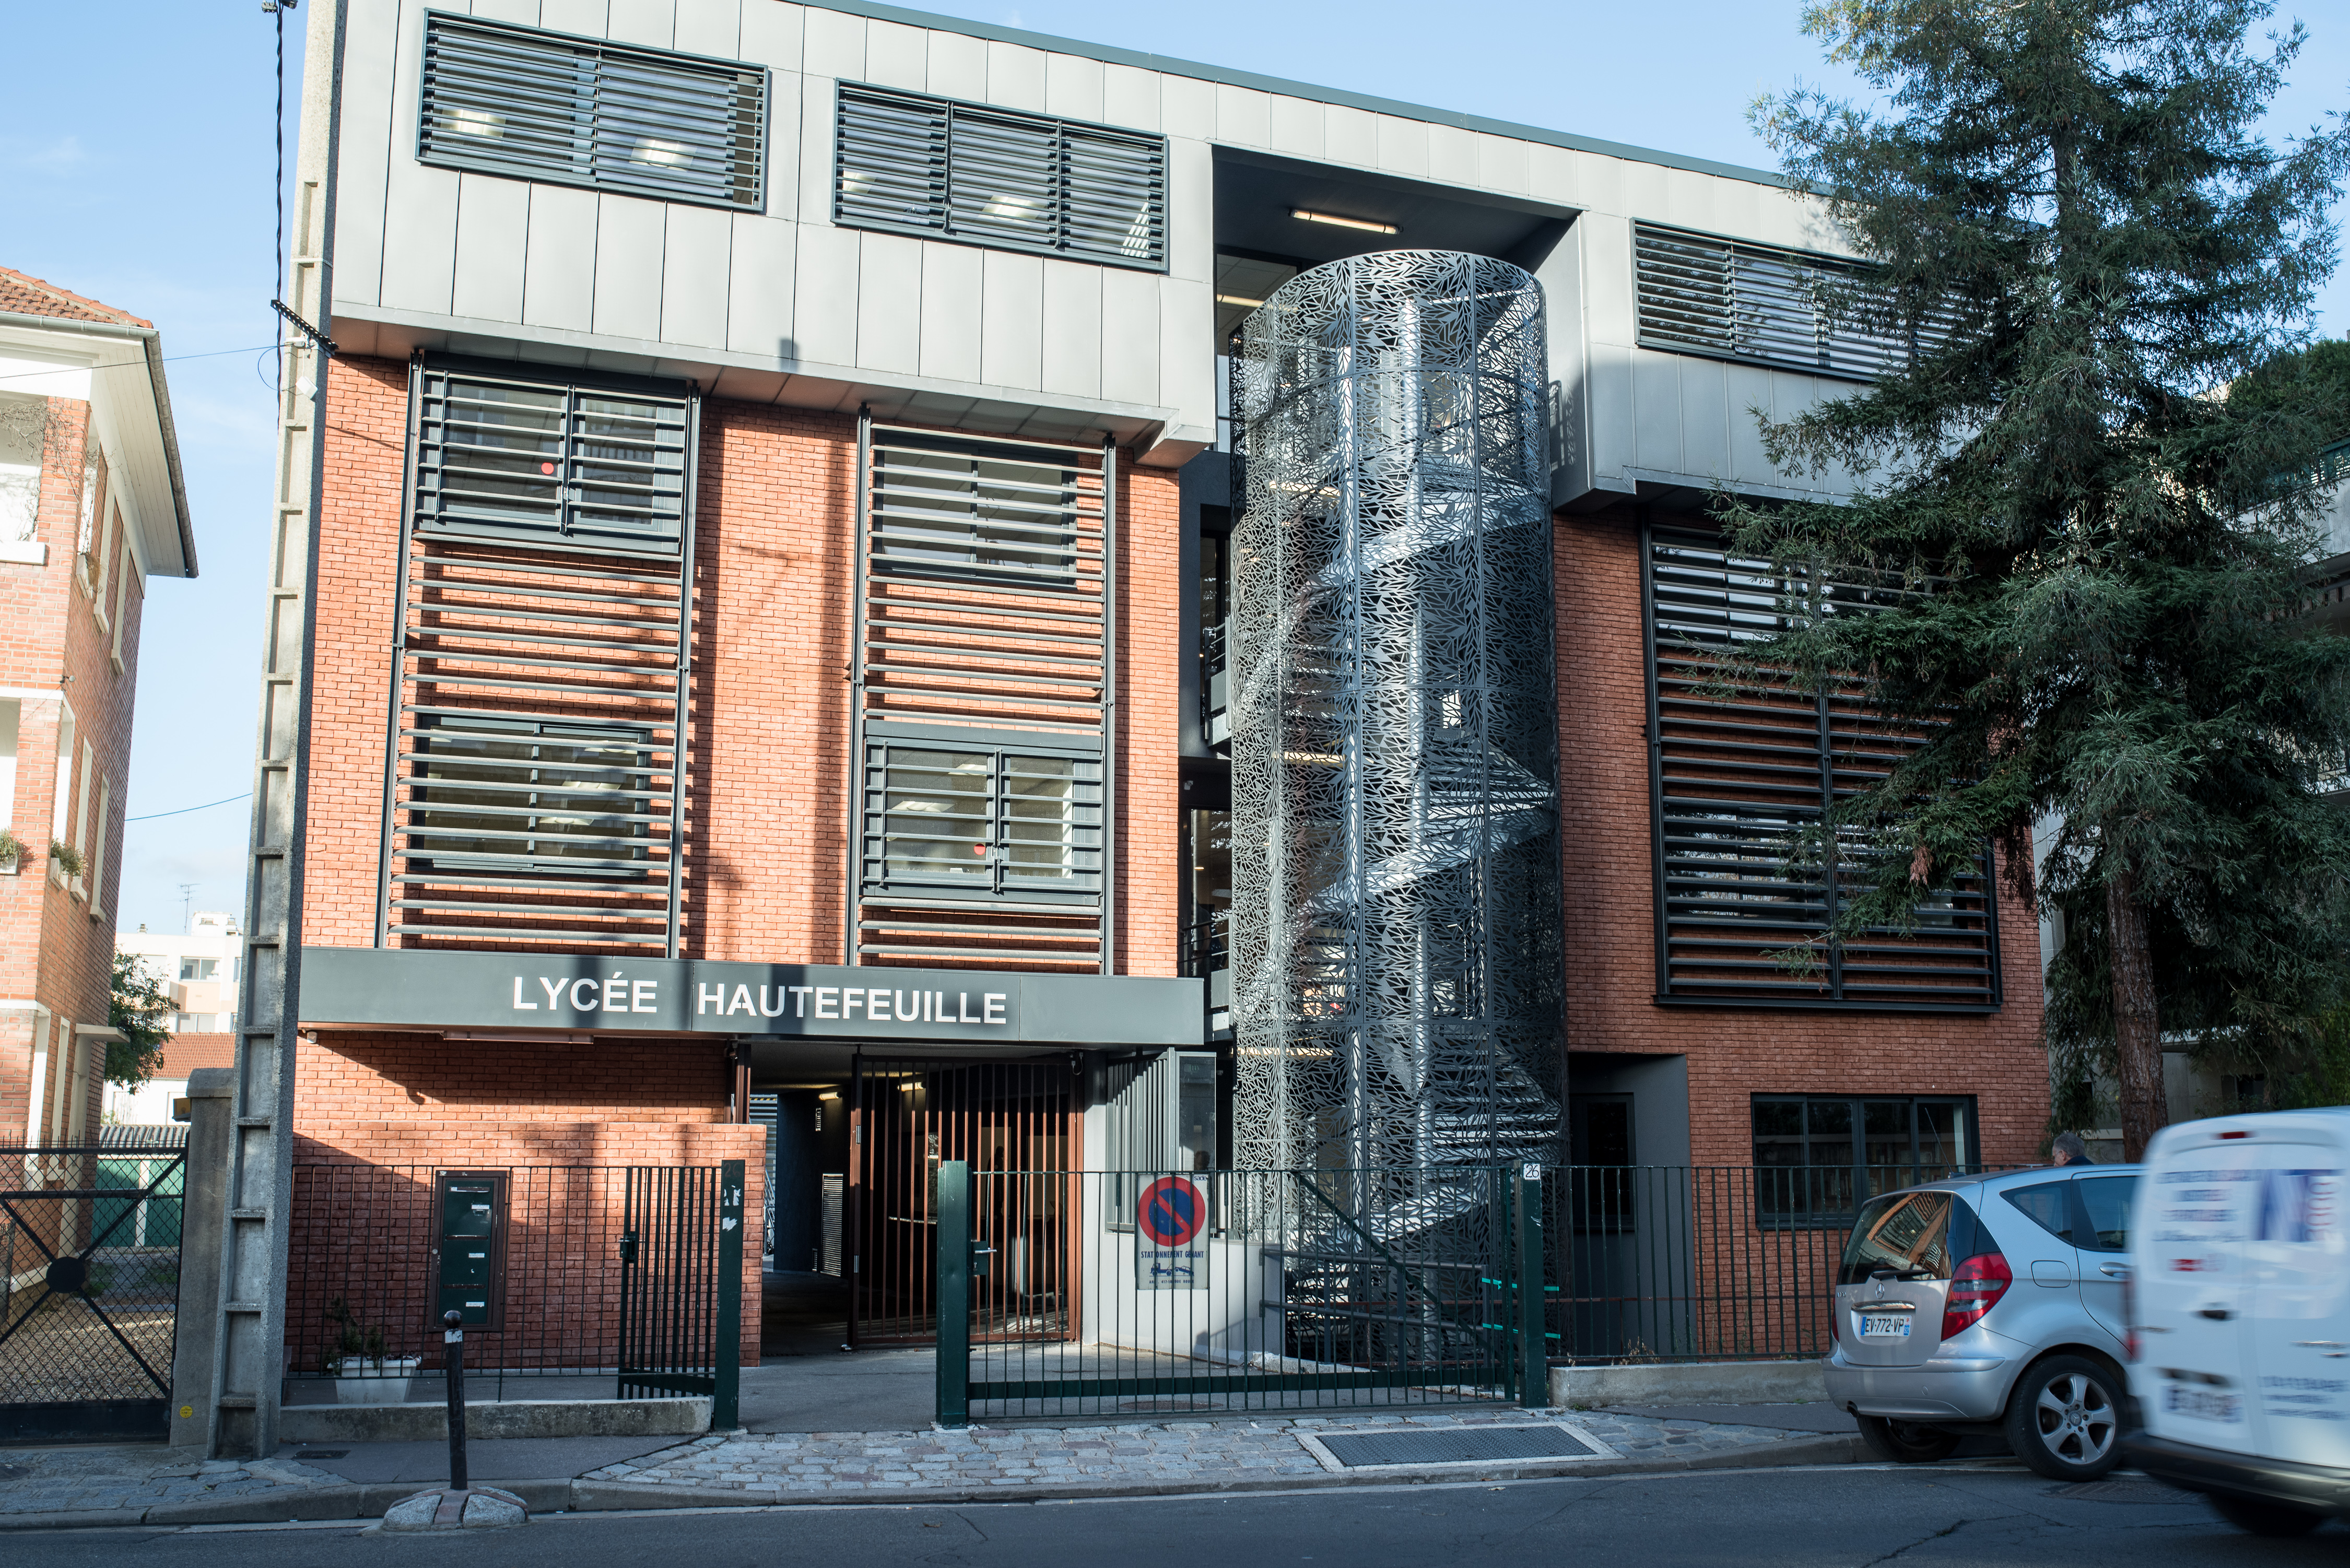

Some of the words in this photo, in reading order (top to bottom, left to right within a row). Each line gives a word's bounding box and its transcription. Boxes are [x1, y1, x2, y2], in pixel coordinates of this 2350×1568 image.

[513, 971, 657, 1013] LYCÉE
[698, 982, 1007, 1024] HAUTEFEUILLE
[1525, 1164, 1539, 1177] 26
[1865, 1318, 1905, 1333] EV-772-VP
